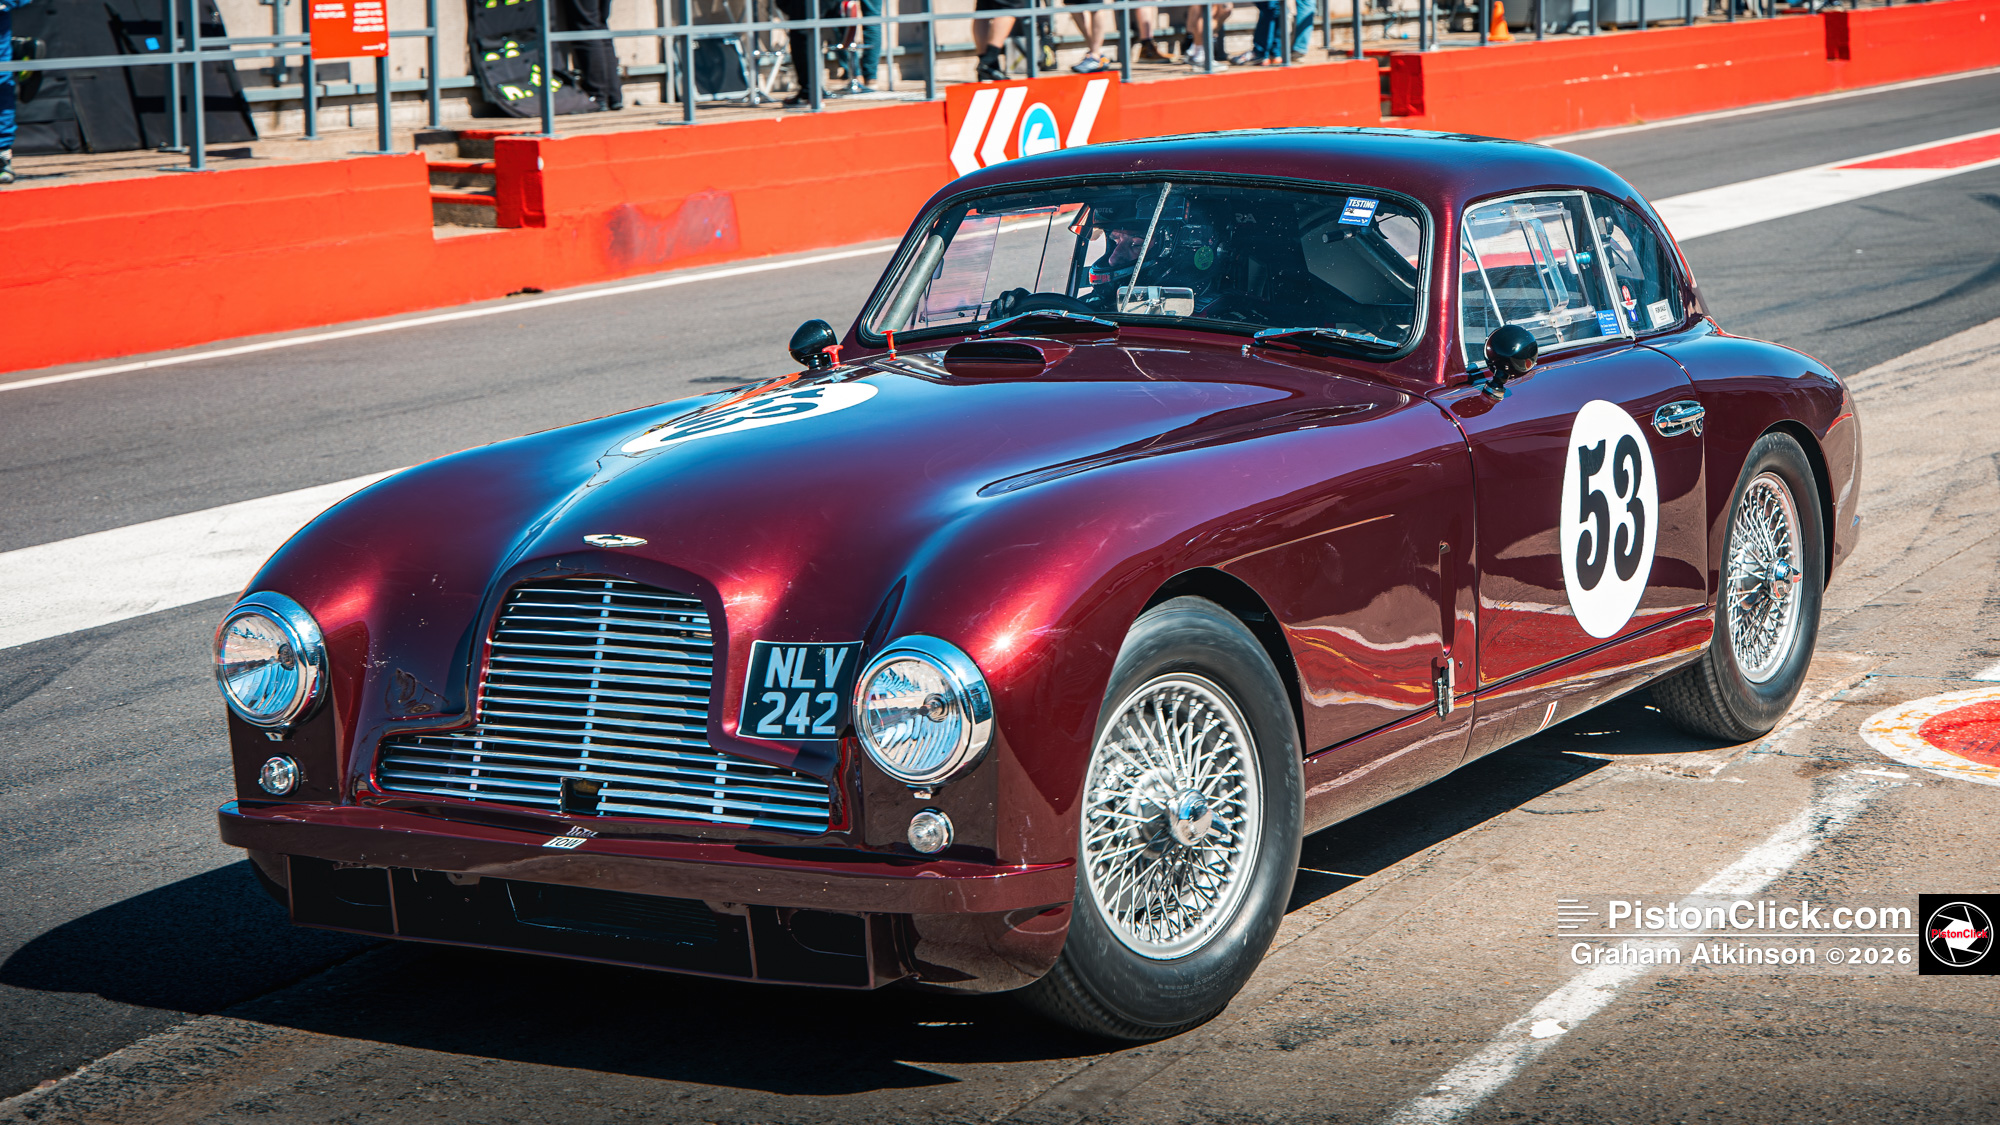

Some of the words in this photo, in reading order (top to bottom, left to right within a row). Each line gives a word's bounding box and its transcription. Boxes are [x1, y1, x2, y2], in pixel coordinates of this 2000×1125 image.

[1349, 199, 1376, 208] TESTING
[1576, 434, 1645, 591] 53
[764, 647, 848, 688] NLV
[757, 692, 838, 734] 242
[549, 837, 584, 847] TOW
